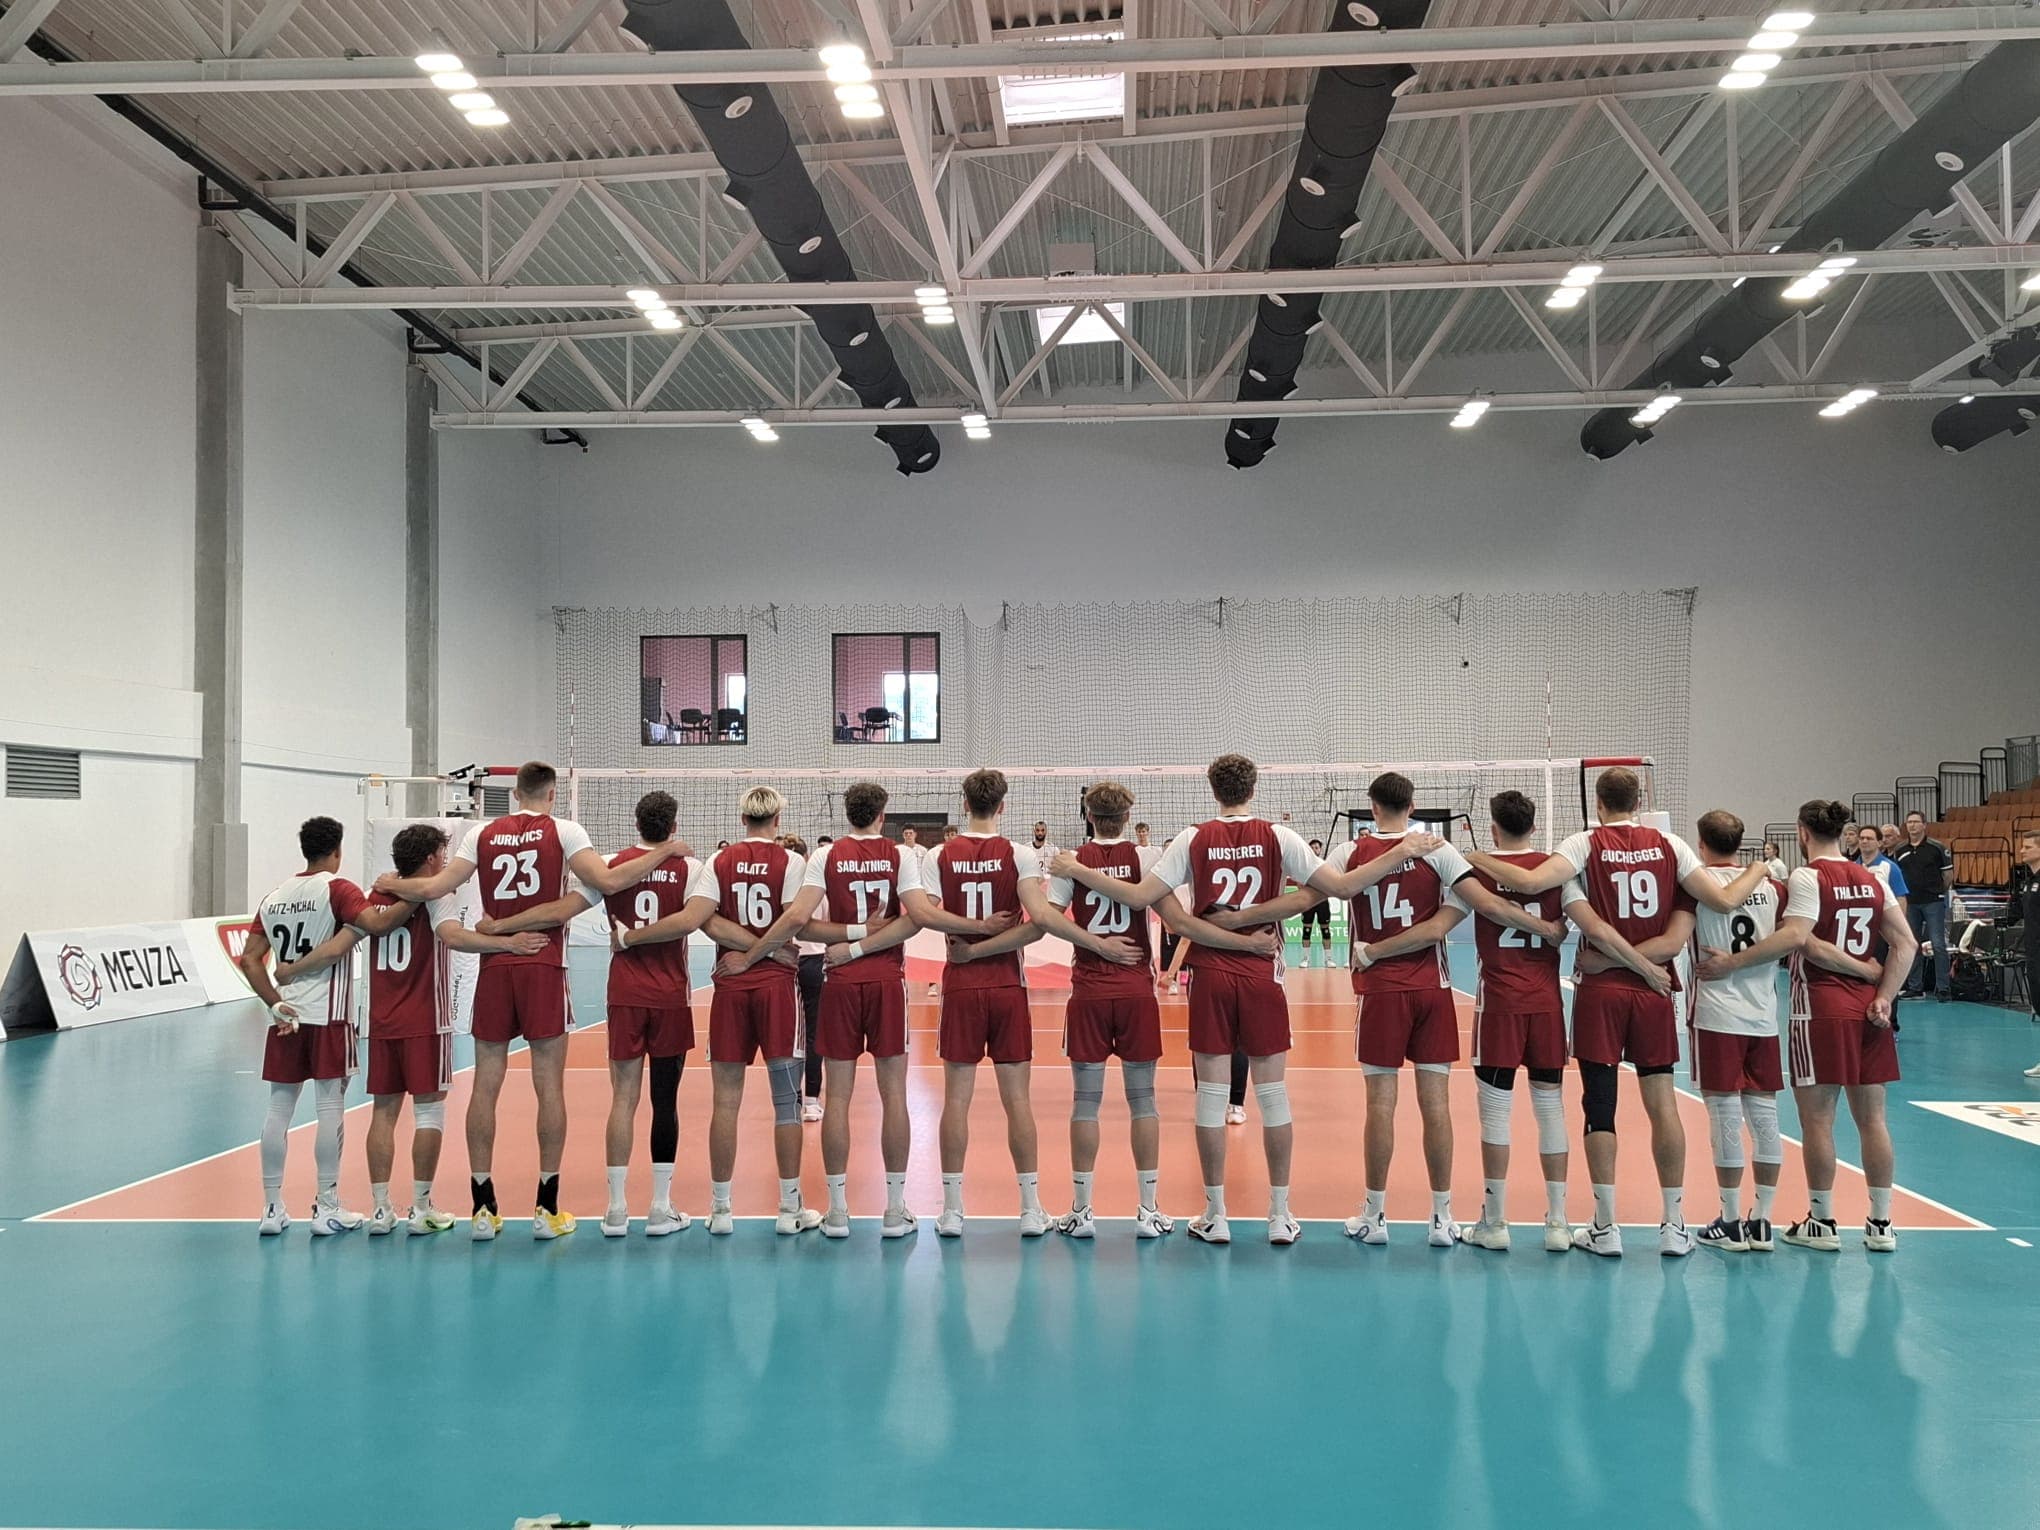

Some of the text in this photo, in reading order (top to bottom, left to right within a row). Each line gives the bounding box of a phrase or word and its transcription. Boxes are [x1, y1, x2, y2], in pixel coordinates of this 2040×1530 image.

[492, 850, 541, 900] 23
[736, 861, 769, 876] GLATZ
[1207, 844, 1264, 861] NUSTERER
[1601, 846, 1664, 864] BUCHEGGER
[634, 890, 659, 930] 9
[731, 882, 773, 929] 16
[849, 879, 890, 924] 17
[960, 881, 994, 922] 11
[1211, 866, 1263, 911] 22
[1363, 883, 1414, 931] 14
[1610, 869, 1659, 919] 19
[1085, 889, 1131, 935] 20
[1730, 914, 1756, 954] 8
[1834, 907, 1874, 956] 13
[272, 921, 313, 965] 24
[376, 926, 412, 972] 10
[100, 945, 188, 993] MEVZA
